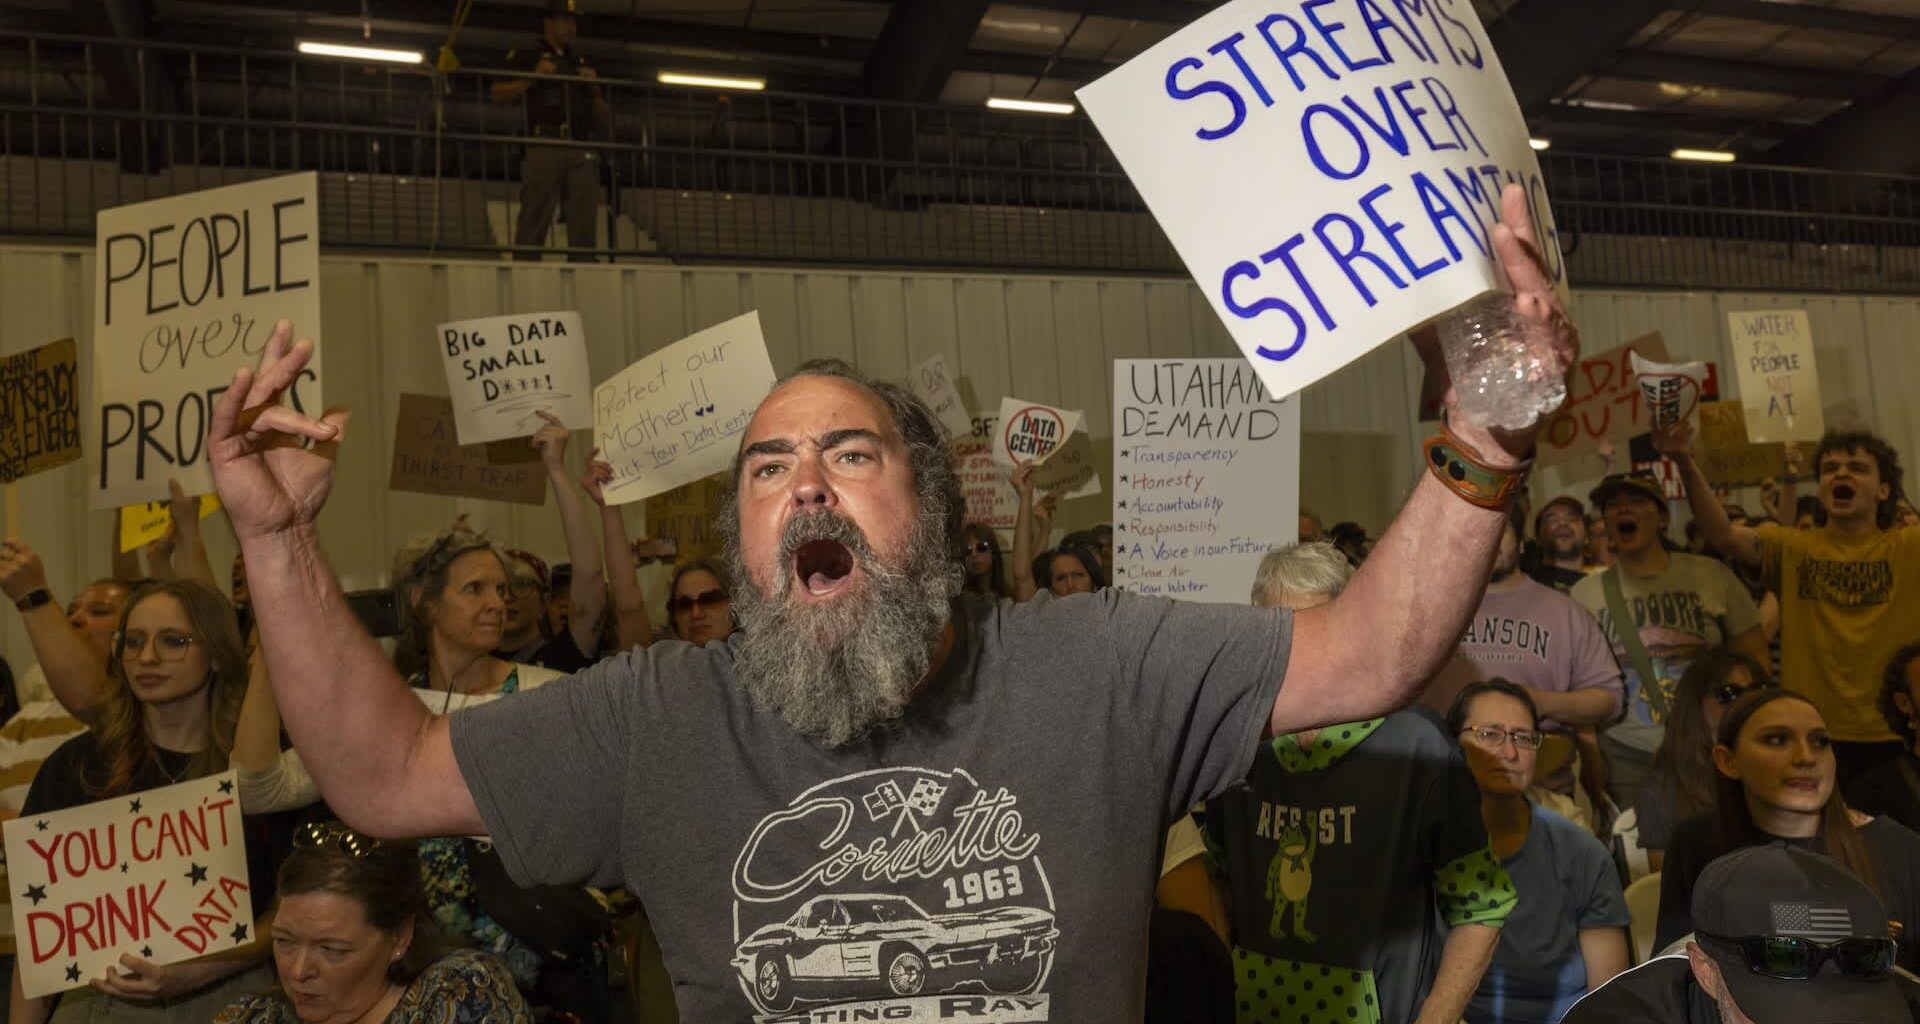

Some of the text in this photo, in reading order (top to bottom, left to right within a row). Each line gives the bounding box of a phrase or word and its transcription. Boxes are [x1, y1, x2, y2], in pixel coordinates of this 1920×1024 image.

[1165, 0, 1484, 140] STREAMS
[1301, 76, 1489, 180] OVER
[104, 198, 310, 326] PEOPLE
[139, 313, 265, 374] over
[444, 319, 567, 357] BIG DATA
[1744, 314, 1796, 337] WATER
[462, 348, 545, 381] SMALL
[596, 340, 732, 426] Protect our
[1751, 354, 1800, 373] PEOPLE
[1131, 361, 1287, 409] UTAHAN
[1768, 393, 1797, 417] AI
[100, 368, 317, 490] PROFS
[1021, 415, 1056, 438] DATA
[1122, 407, 1280, 441] DEMAND
[1550, 389, 1641, 449] OUT
[1130, 445, 1240, 468] Transparency
[477, 467, 529, 489] TRAP
[1132, 469, 1205, 492] Honesty
[1128, 496, 1225, 516] Accountability
[1130, 517, 1219, 542] Responsibility
[1129, 542, 1143, 560] A
[1152, 542, 1188, 561] Voice
[1168, 581, 1208, 594] Water
[1460, 617, 1550, 660] ANSON
[26, 796, 235, 884] YOU CAN'T
[1256, 800, 1357, 845] RESST
[732, 787, 1040, 902] Corvette
[943, 865, 1024, 908] 1963
[26, 879, 172, 964] DRINK
[173, 875, 249, 954] DATA
[939, 998, 1045, 1018] RAY
